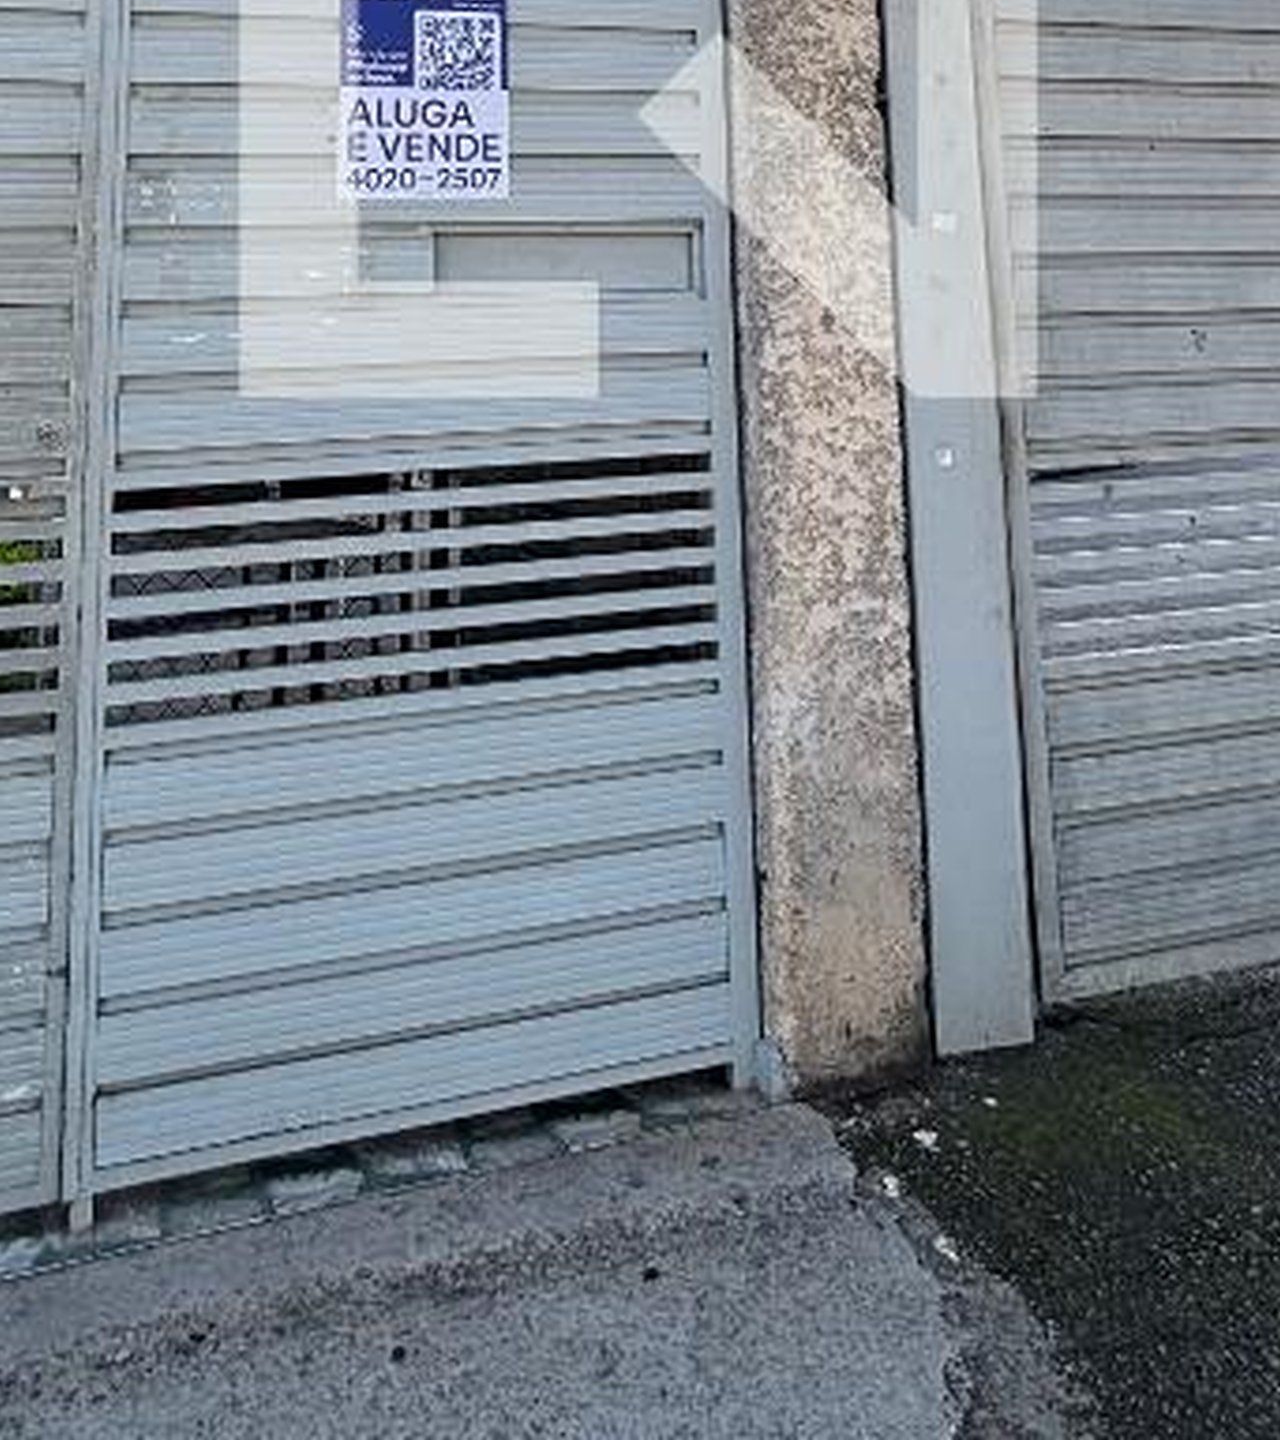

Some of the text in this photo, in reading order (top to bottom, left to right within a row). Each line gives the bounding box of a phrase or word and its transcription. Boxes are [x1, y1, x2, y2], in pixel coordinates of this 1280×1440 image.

[348, 97, 475, 129] ALUGA
[347, 131, 502, 163] E VENDE
[347, 167, 503, 193] 4020-2507
